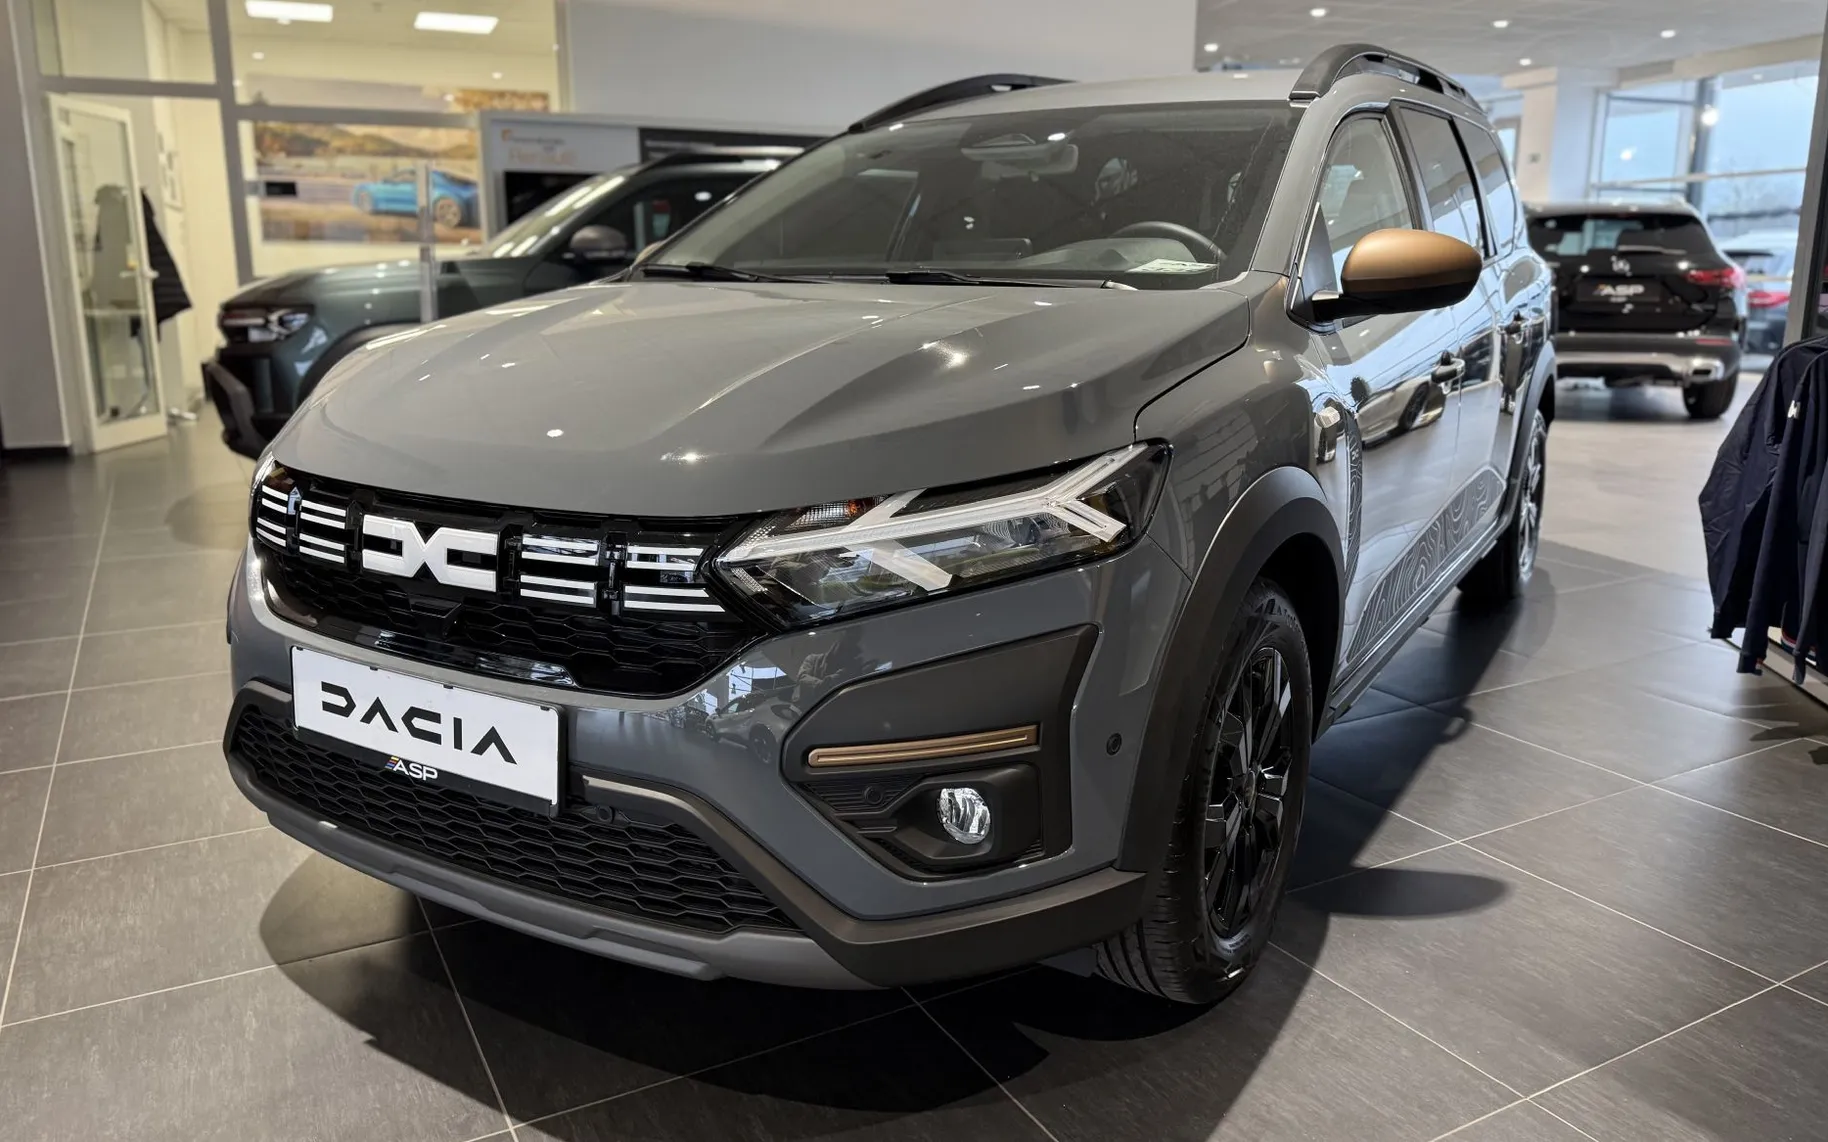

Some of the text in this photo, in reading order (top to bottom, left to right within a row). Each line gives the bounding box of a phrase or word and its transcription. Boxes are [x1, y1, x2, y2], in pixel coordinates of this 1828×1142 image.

[1600, 284, 1645, 297] ASP
[321, 681, 517, 765] DACIA
[393, 759, 438, 781] ASP
